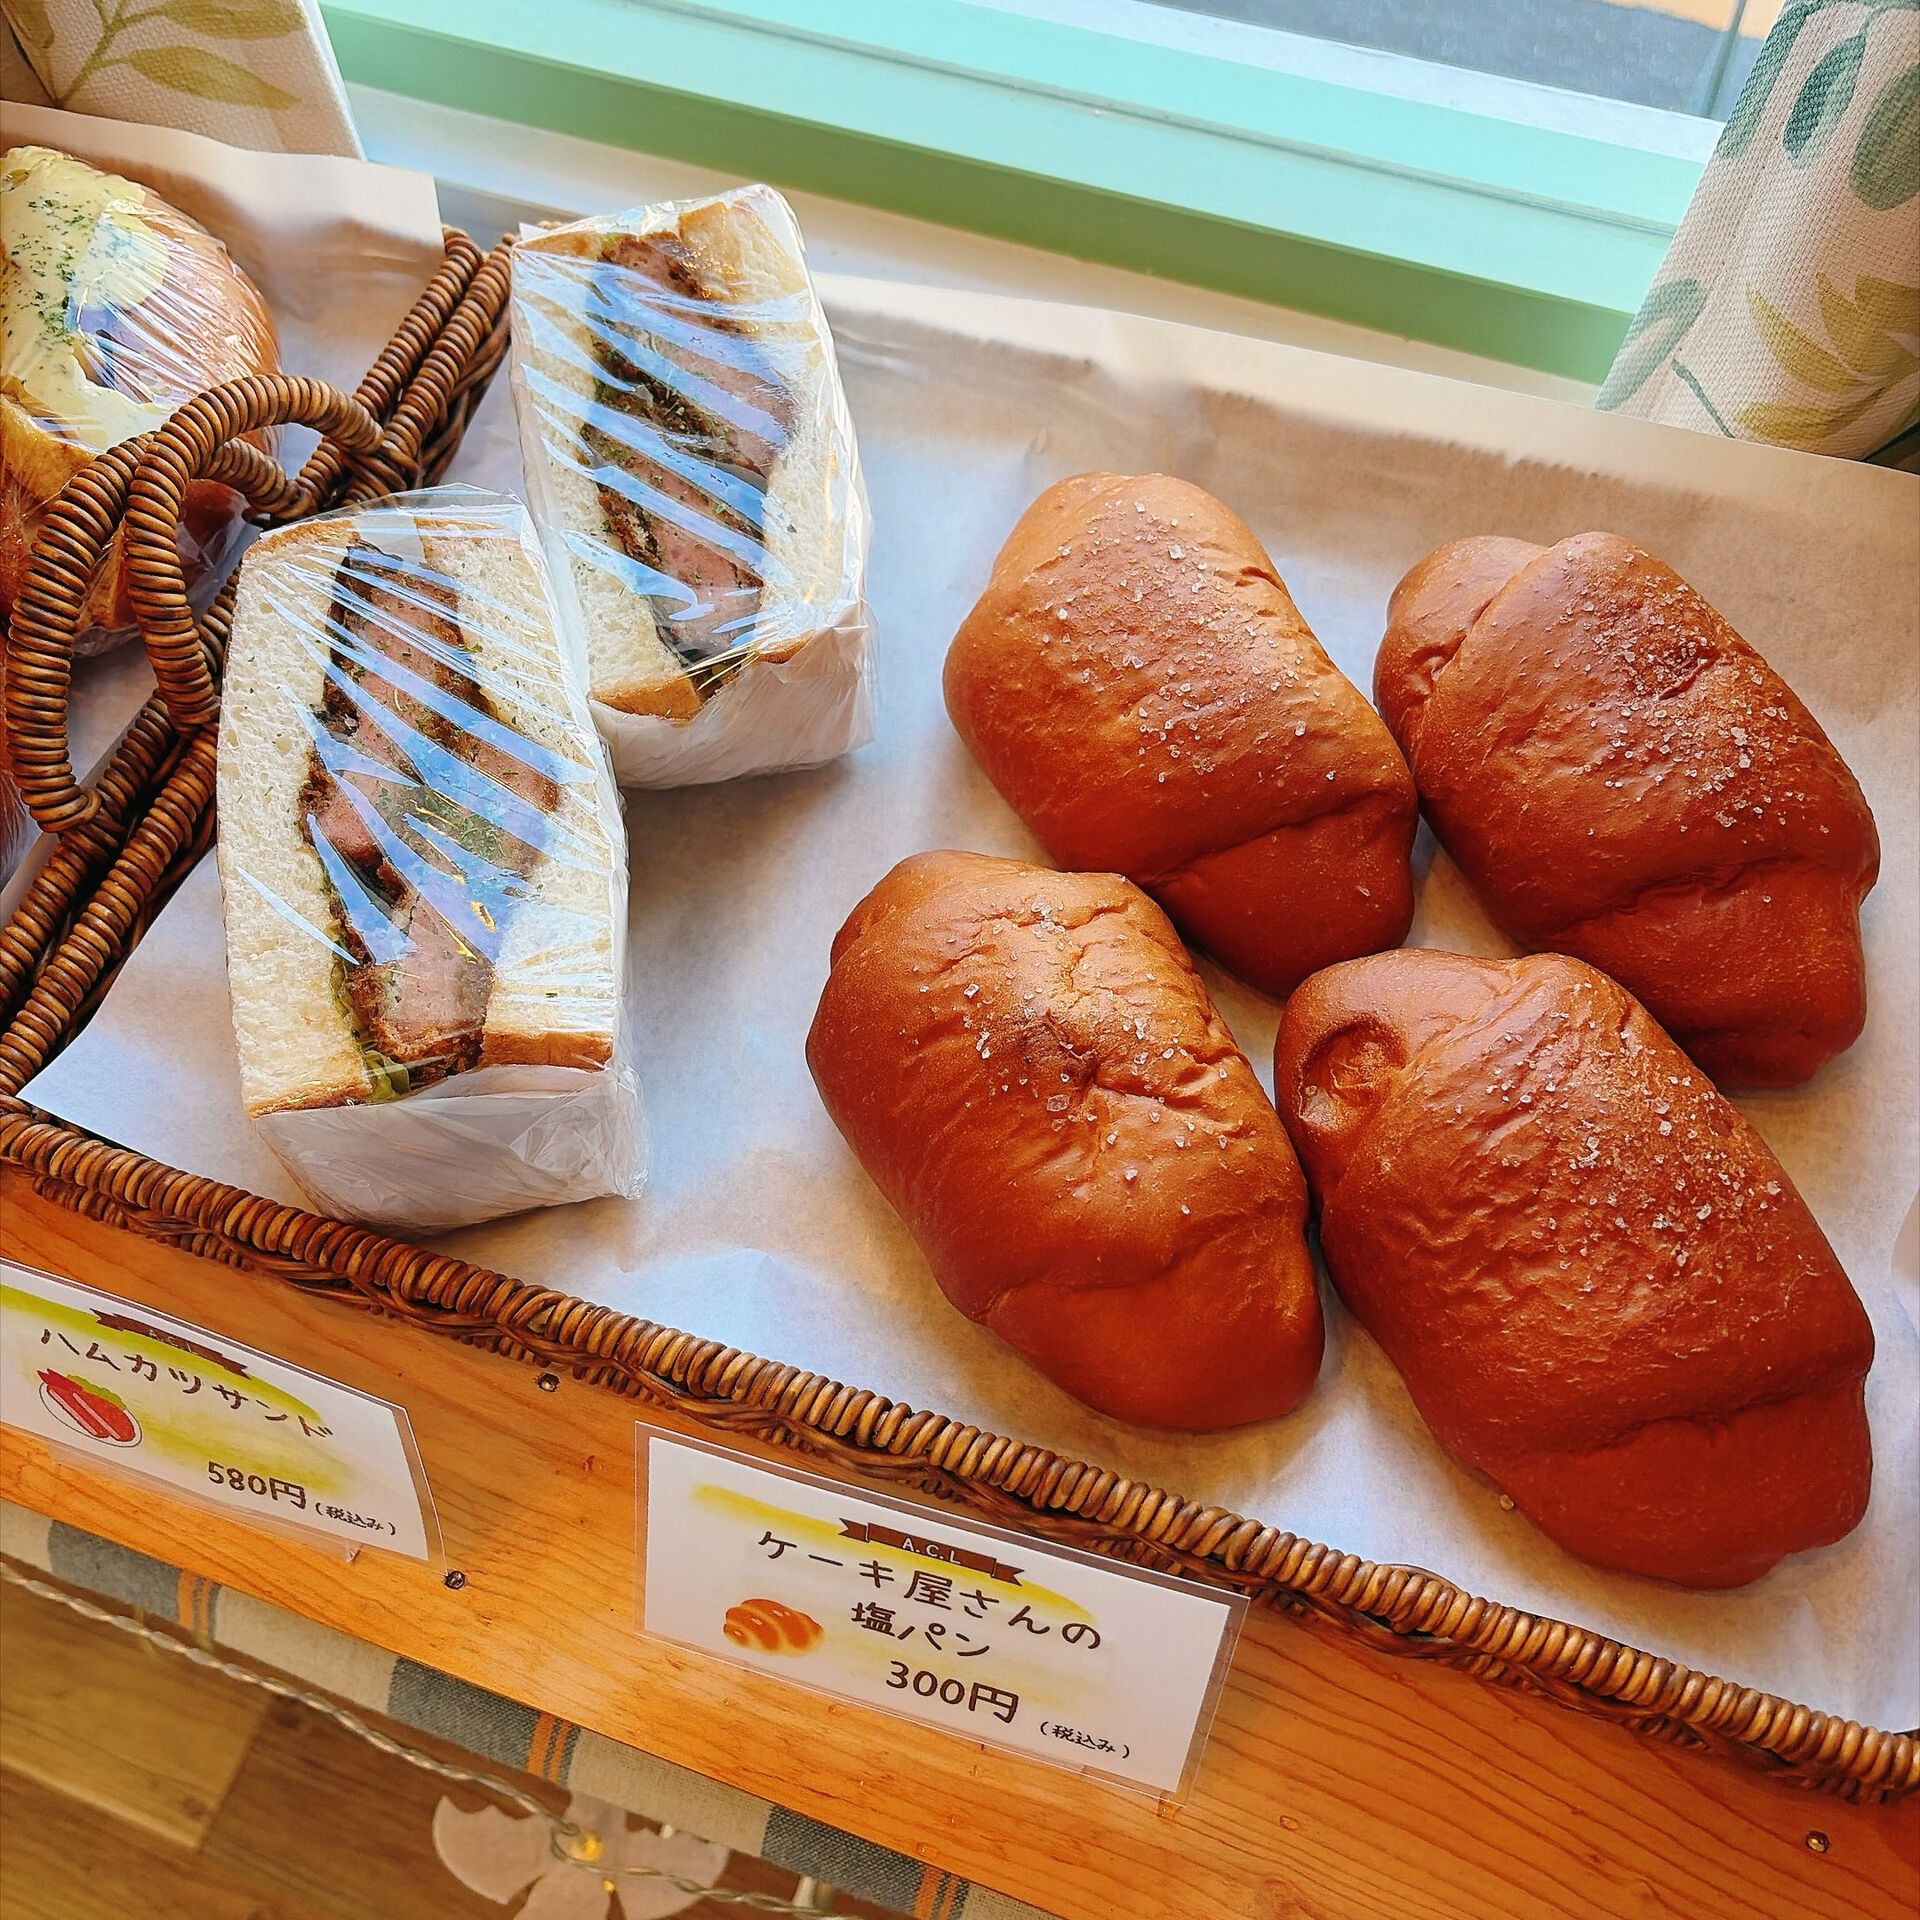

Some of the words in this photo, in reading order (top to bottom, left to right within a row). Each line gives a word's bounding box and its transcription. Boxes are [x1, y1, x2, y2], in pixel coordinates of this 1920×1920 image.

[41, 1329, 334, 1439] ハムカツサンド
[208, 1461, 306, 1510] 580円
[315, 1502, 396, 1536] (税込み)
[759, 1530, 1101, 1650] ケーキ屋さんの
[851, 1601, 990, 1657] 塩パン
[886, 1660, 1019, 1724] 300円
[1040, 1721, 1130, 1759] (税込み)
